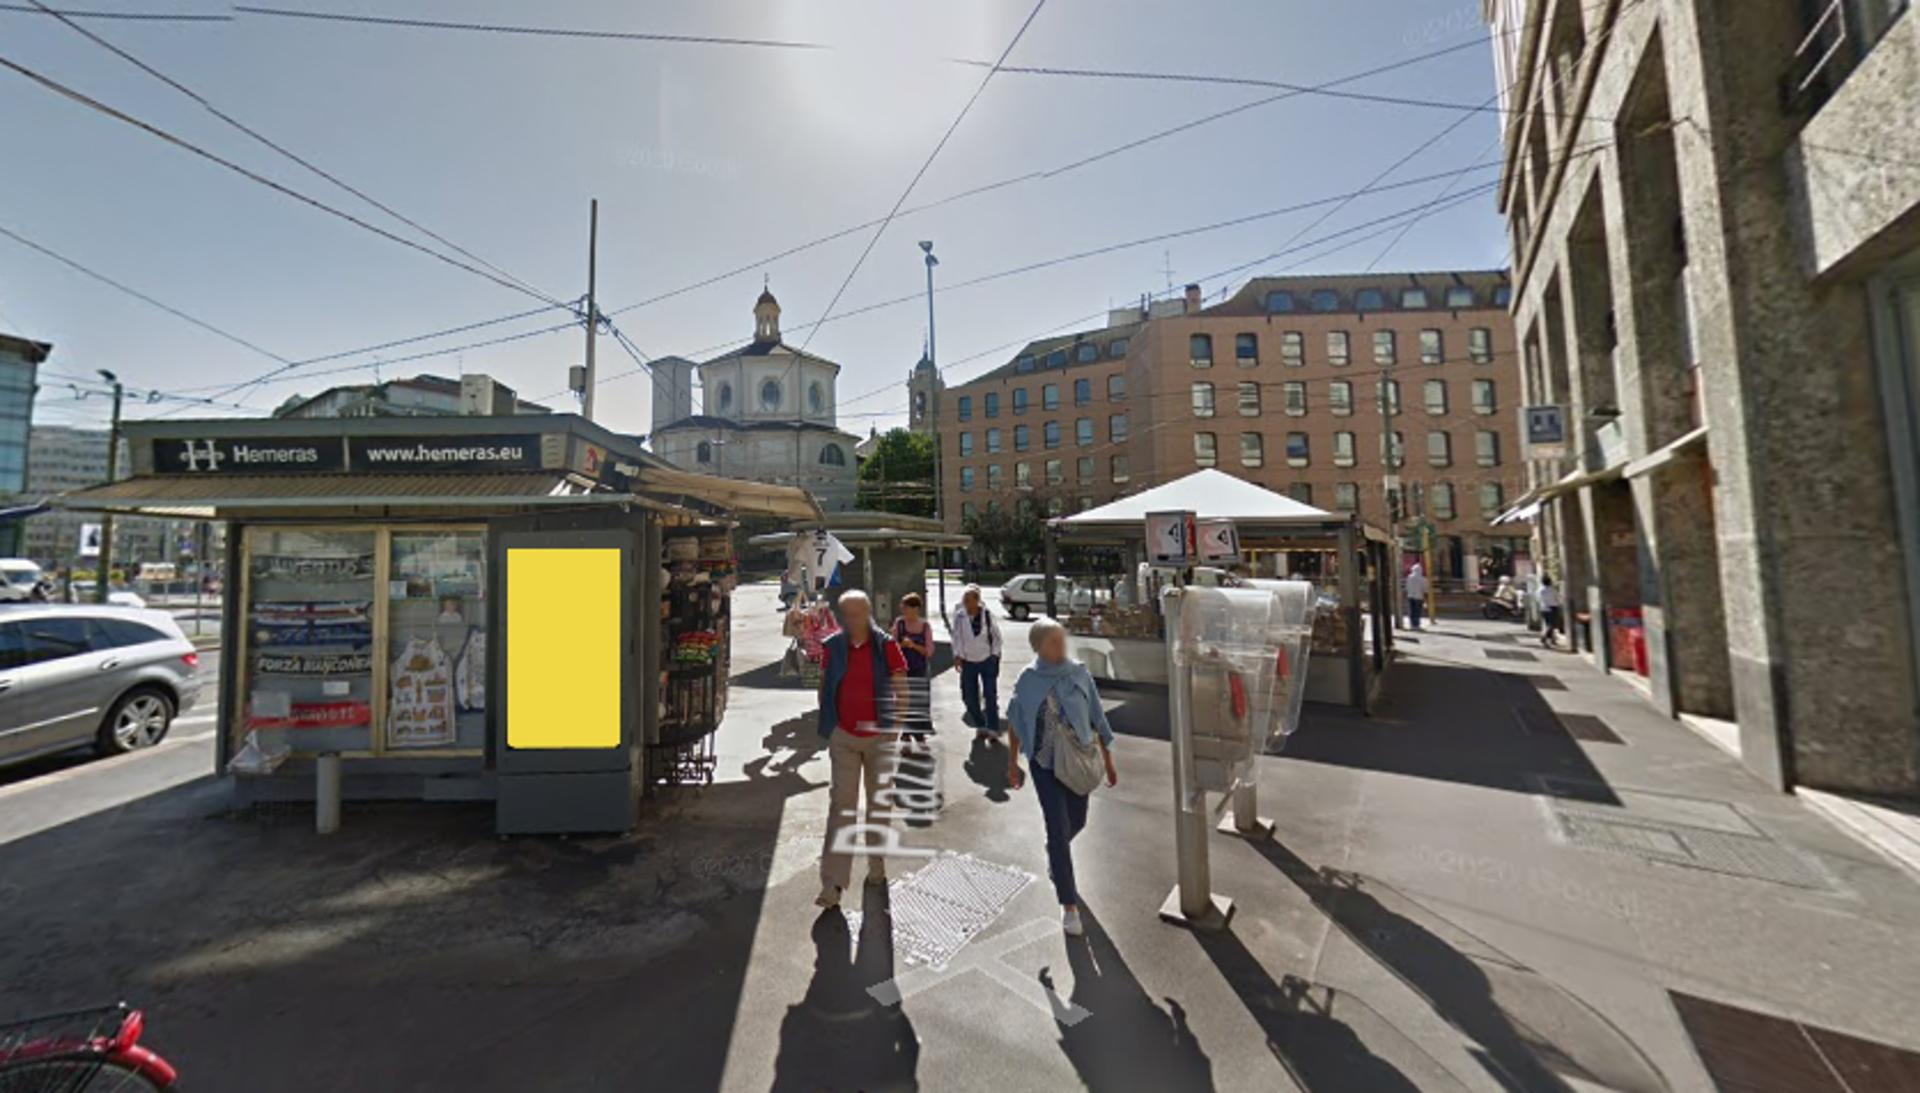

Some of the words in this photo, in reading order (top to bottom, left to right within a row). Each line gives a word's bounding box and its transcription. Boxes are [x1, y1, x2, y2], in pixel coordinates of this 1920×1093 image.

[233, 445, 318, 463] Hemeras
[367, 443, 523, 462] www.hemeras.eu
[815, 548, 827, 567] 7
